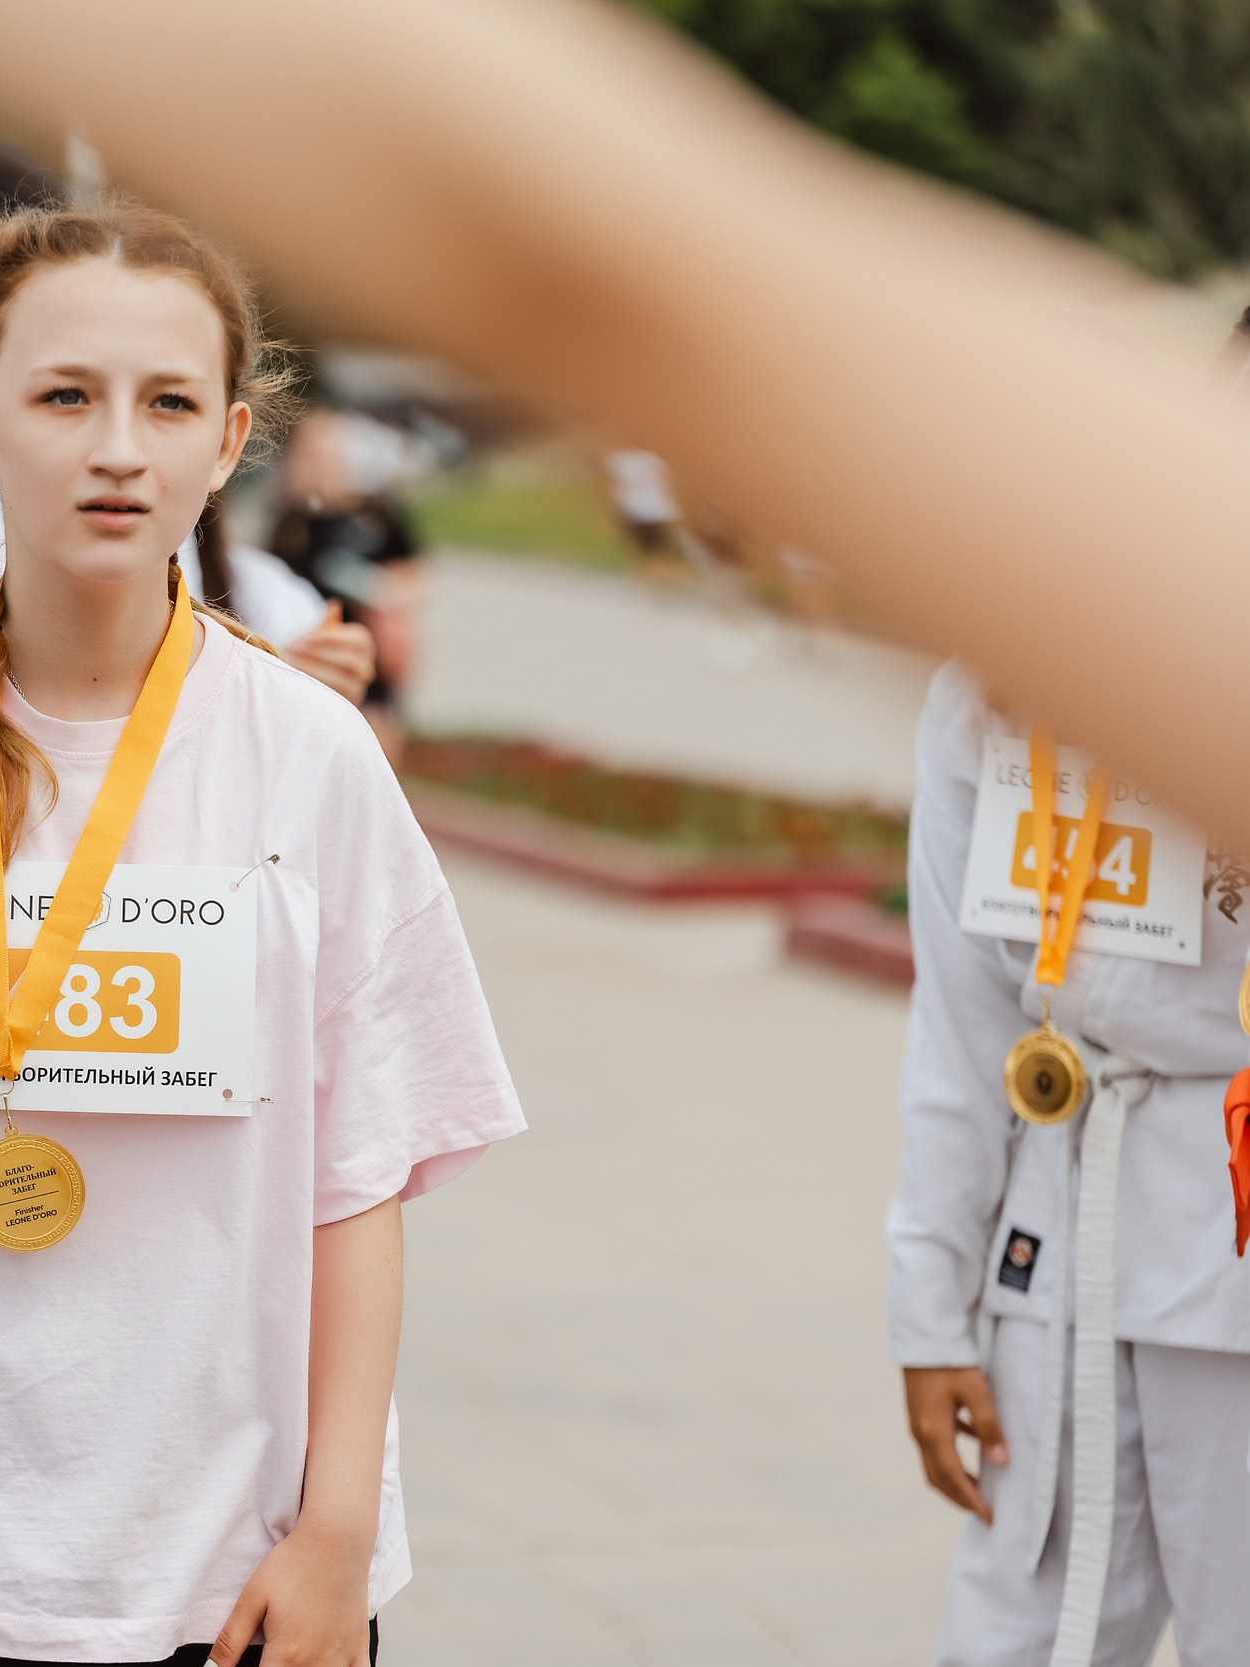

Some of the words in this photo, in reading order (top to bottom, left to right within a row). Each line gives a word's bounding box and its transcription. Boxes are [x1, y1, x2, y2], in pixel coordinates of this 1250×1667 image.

[122, 897, 225, 926] D'ORO
[36, 963, 158, 1040] 83
[160, 1069, 218, 1088] ЗАБЕГ
[5, 1164, 35, 1177] БЛАГО-
[11, 1183, 37, 1195] ЗАБЕГ
[5, 1215, 32, 1227] LEONE
[32, 1209, 58, 1221] D'ORO
[14, 1205, 44, 1216] Finisher
